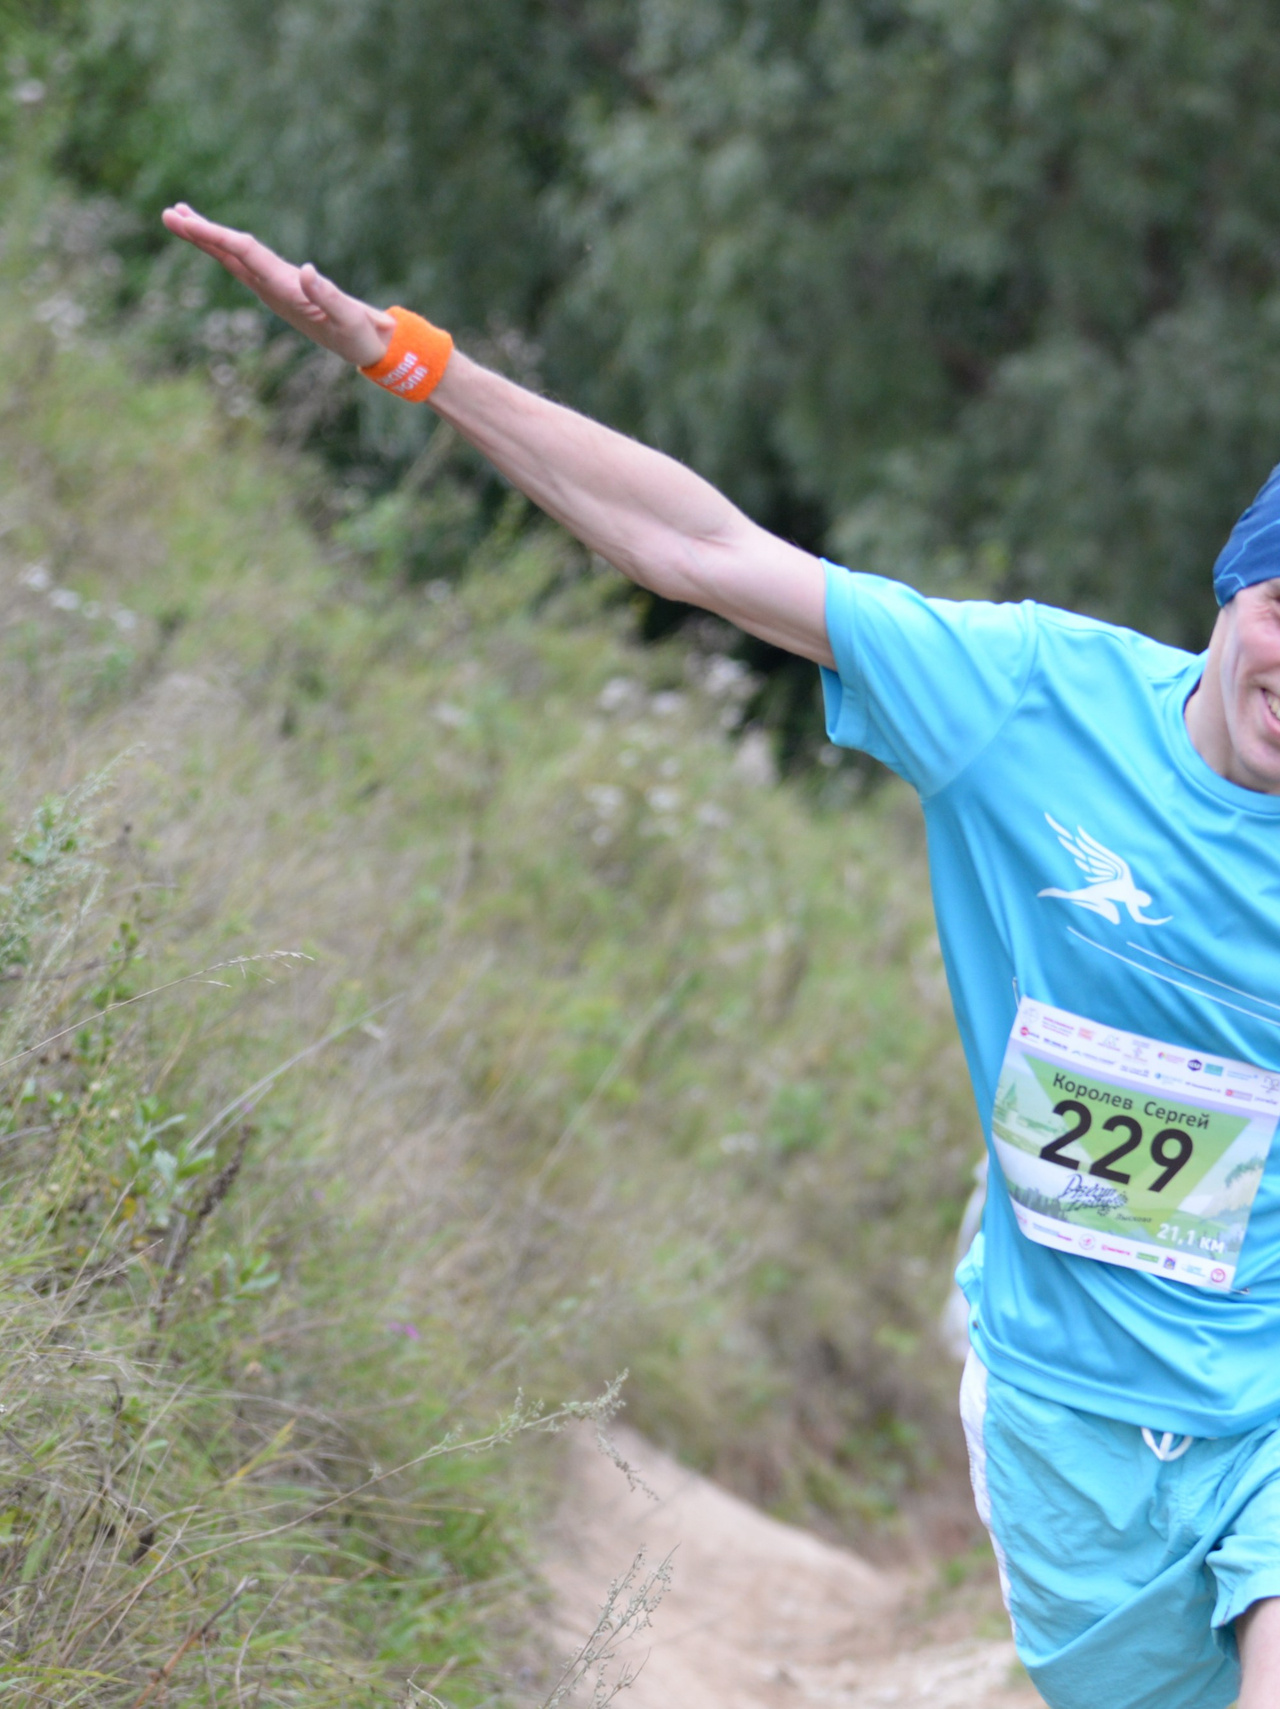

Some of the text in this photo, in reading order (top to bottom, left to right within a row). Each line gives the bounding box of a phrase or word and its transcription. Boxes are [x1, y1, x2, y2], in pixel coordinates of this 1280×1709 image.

[1052, 1071, 1133, 1111] Королев
[1143, 1100, 1211, 1131] Сергей
[1039, 1099, 1194, 1193] 229
[1156, 1222, 1196, 1247] 21,1
